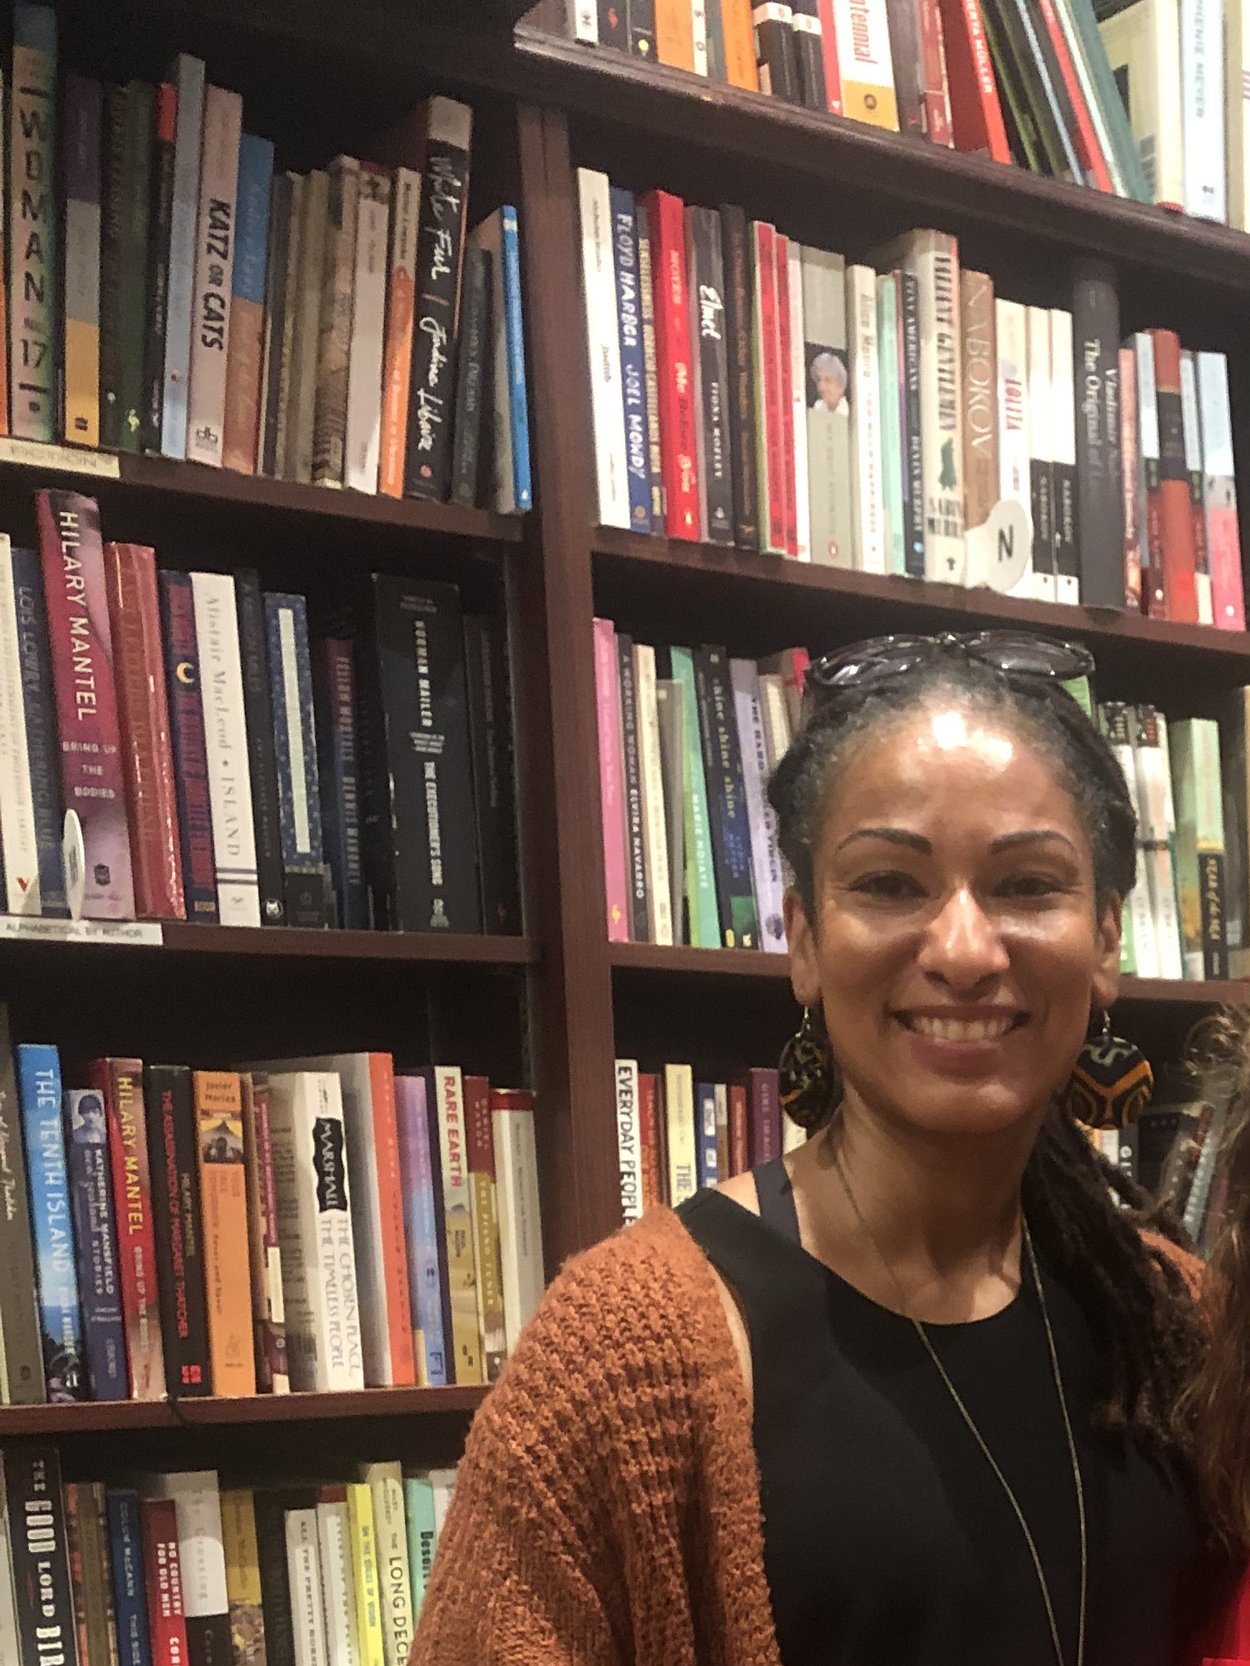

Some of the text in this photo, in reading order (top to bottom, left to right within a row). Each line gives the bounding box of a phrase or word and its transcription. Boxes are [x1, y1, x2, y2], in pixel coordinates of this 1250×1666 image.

[426, 156, 461, 220] White
[206, 198, 231, 261] KATZ
[616, 214, 635, 268] FLOYD
[201, 291, 226, 352] CATS
[626, 364, 641, 406] JOEL
[966, 284, 993, 455] NABOKOV
[1083, 338, 1099, 373] The
[628, 414, 647, 480] MOWDY
[998, 526, 1014, 562] N
[60, 511, 98, 722] HILARY MANTEL
[206, 593, 227, 663] Alistair
[221, 776, 242, 857] ISLAND
[633, 837, 645, 899] NAVARRO
[35, 1067, 56, 1110] THE
[117, 1076, 138, 1149] HILARY
[618, 1065, 635, 1156] EVERYDAY
[40, 1116, 66, 1187] TENTH
[443, 1075, 463, 1188] RARE EARTH
[123, 1156, 144, 1236] MANTEL
[320, 1121, 341, 1208] MARSHALL
[676, 1163, 693, 1194] THE
[46, 1192, 70, 1273] ISLAND
[100, 1222, 115, 1295] MANSFIELD
[37, 1561, 57, 1617] LORD
[160, 1568, 169, 1589] OLD
[389, 1556, 407, 1610] LONG
